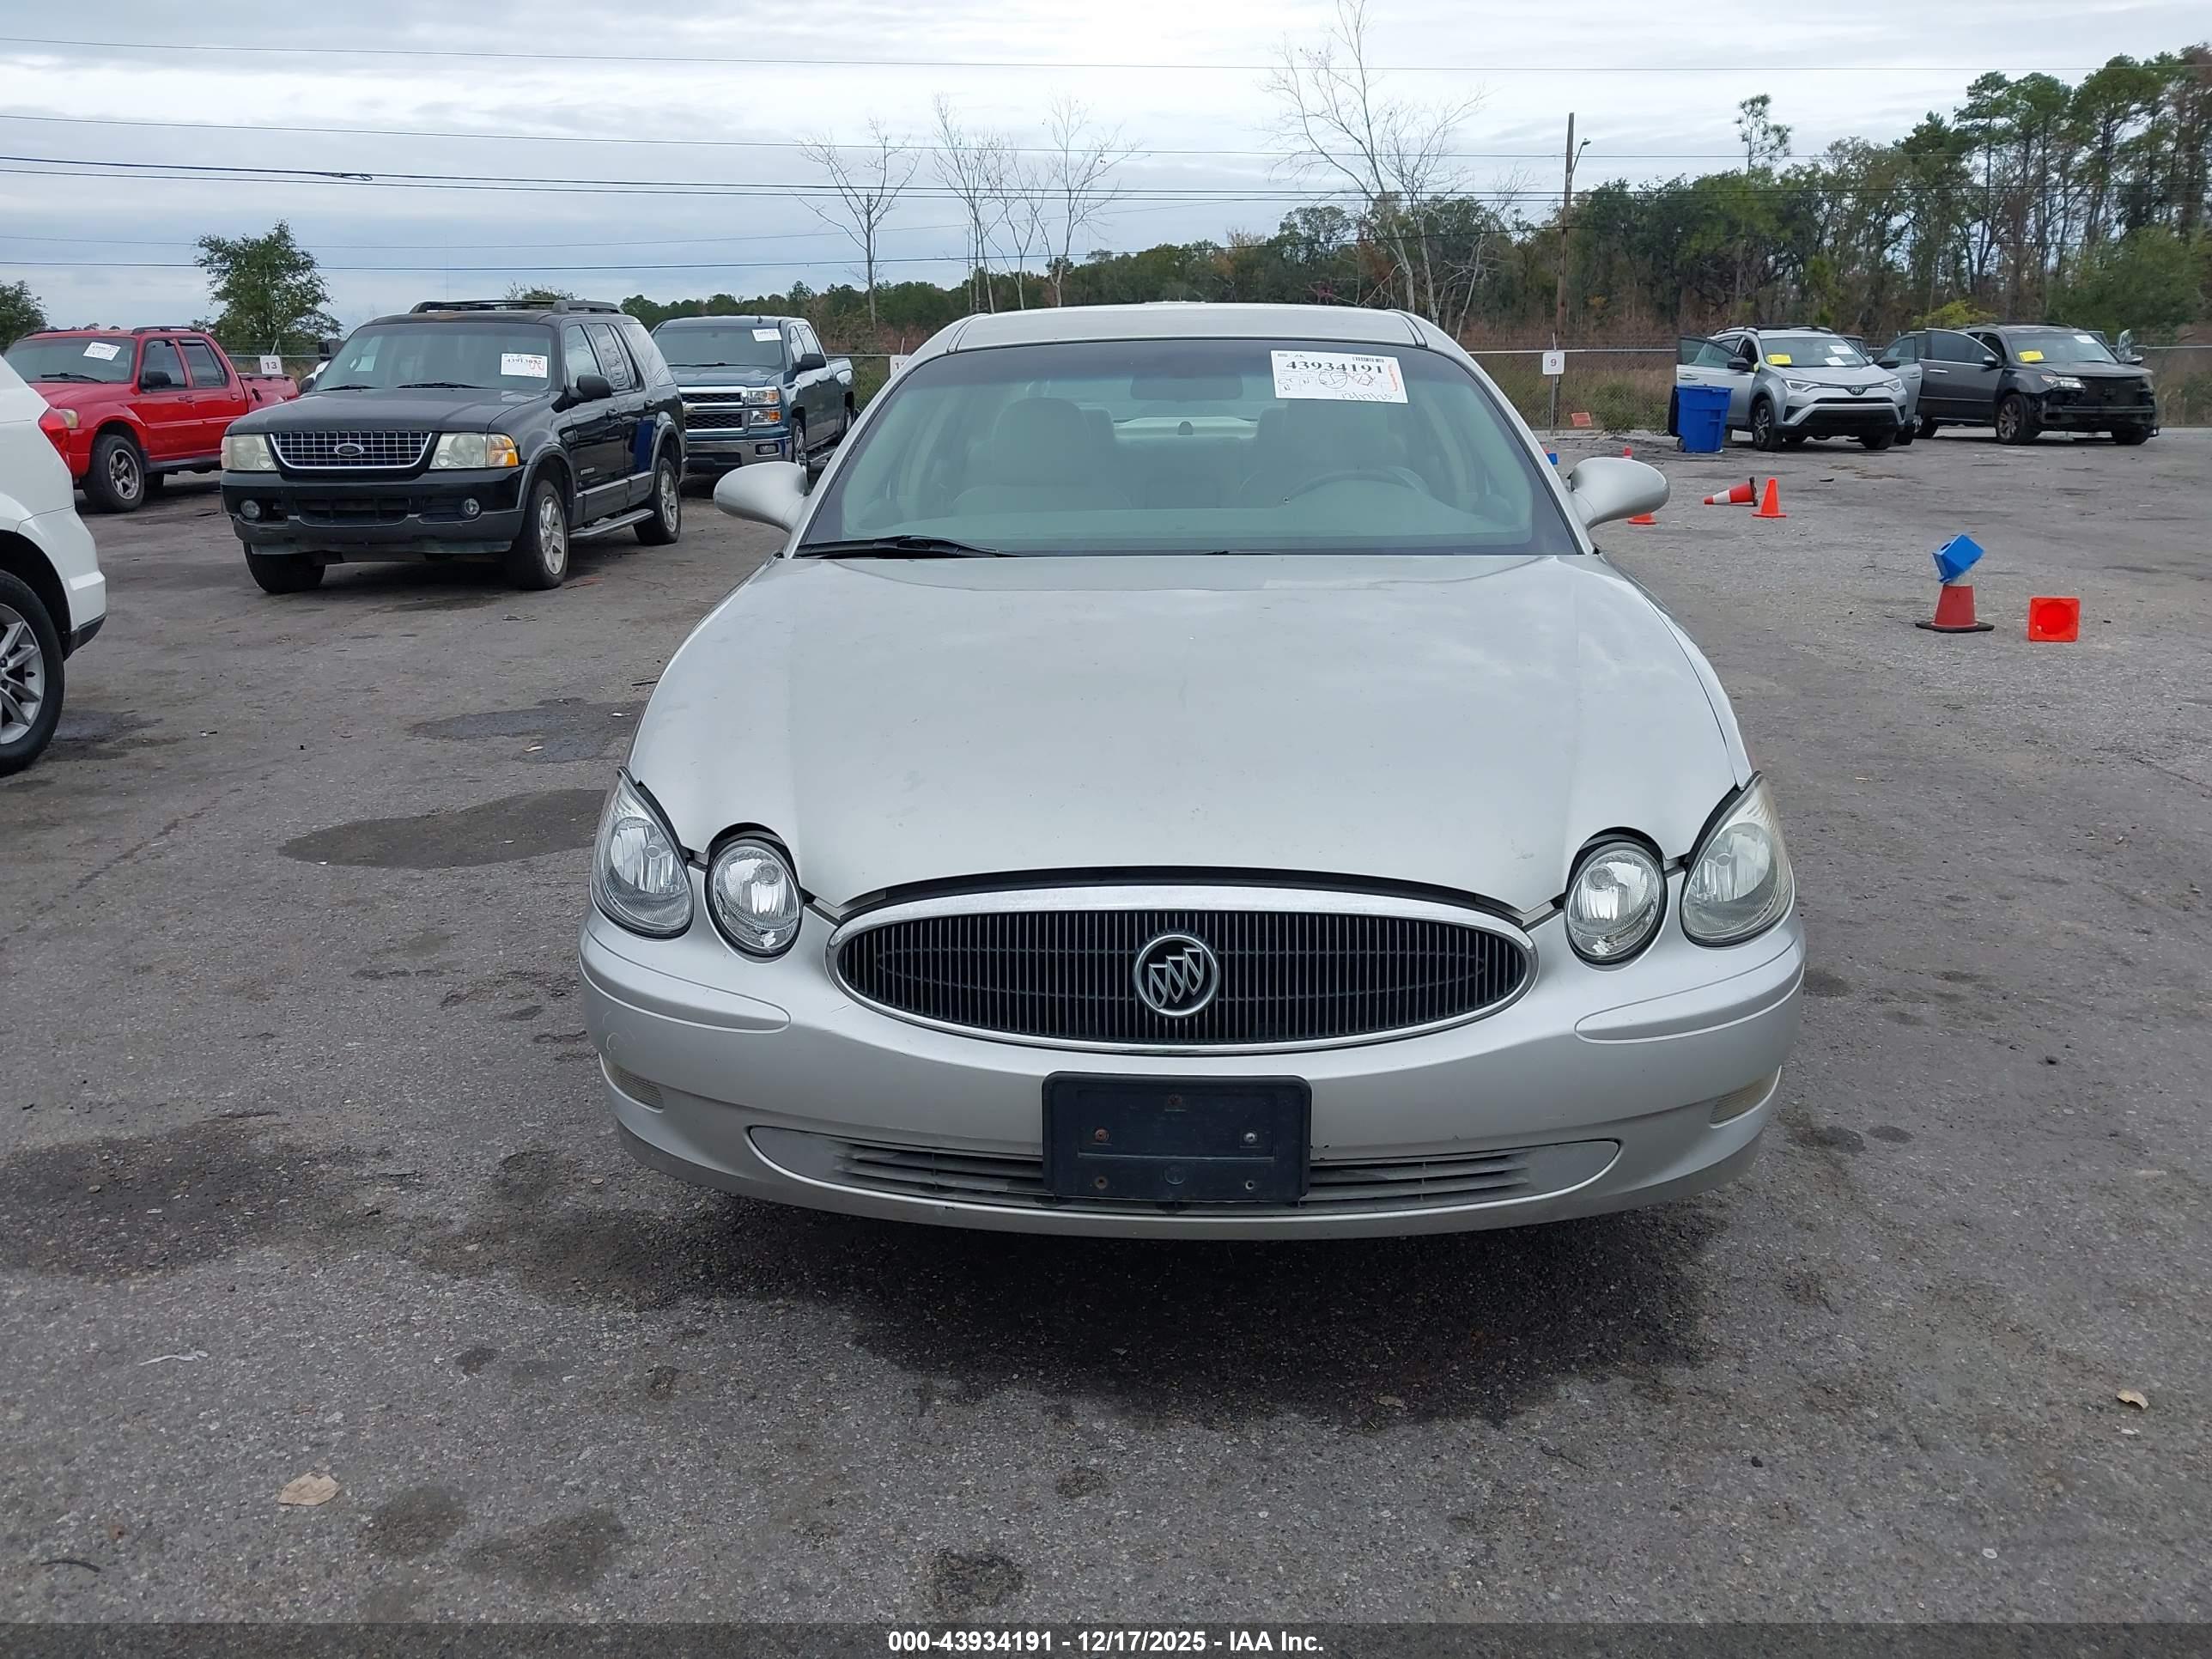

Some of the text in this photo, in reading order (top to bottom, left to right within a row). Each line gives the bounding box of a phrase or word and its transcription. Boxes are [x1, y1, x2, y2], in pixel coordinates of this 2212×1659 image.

[264, 362, 278, 370] 13
[1550, 358, 1558, 367] 9
[1285, 361, 1382, 374] 43934191
